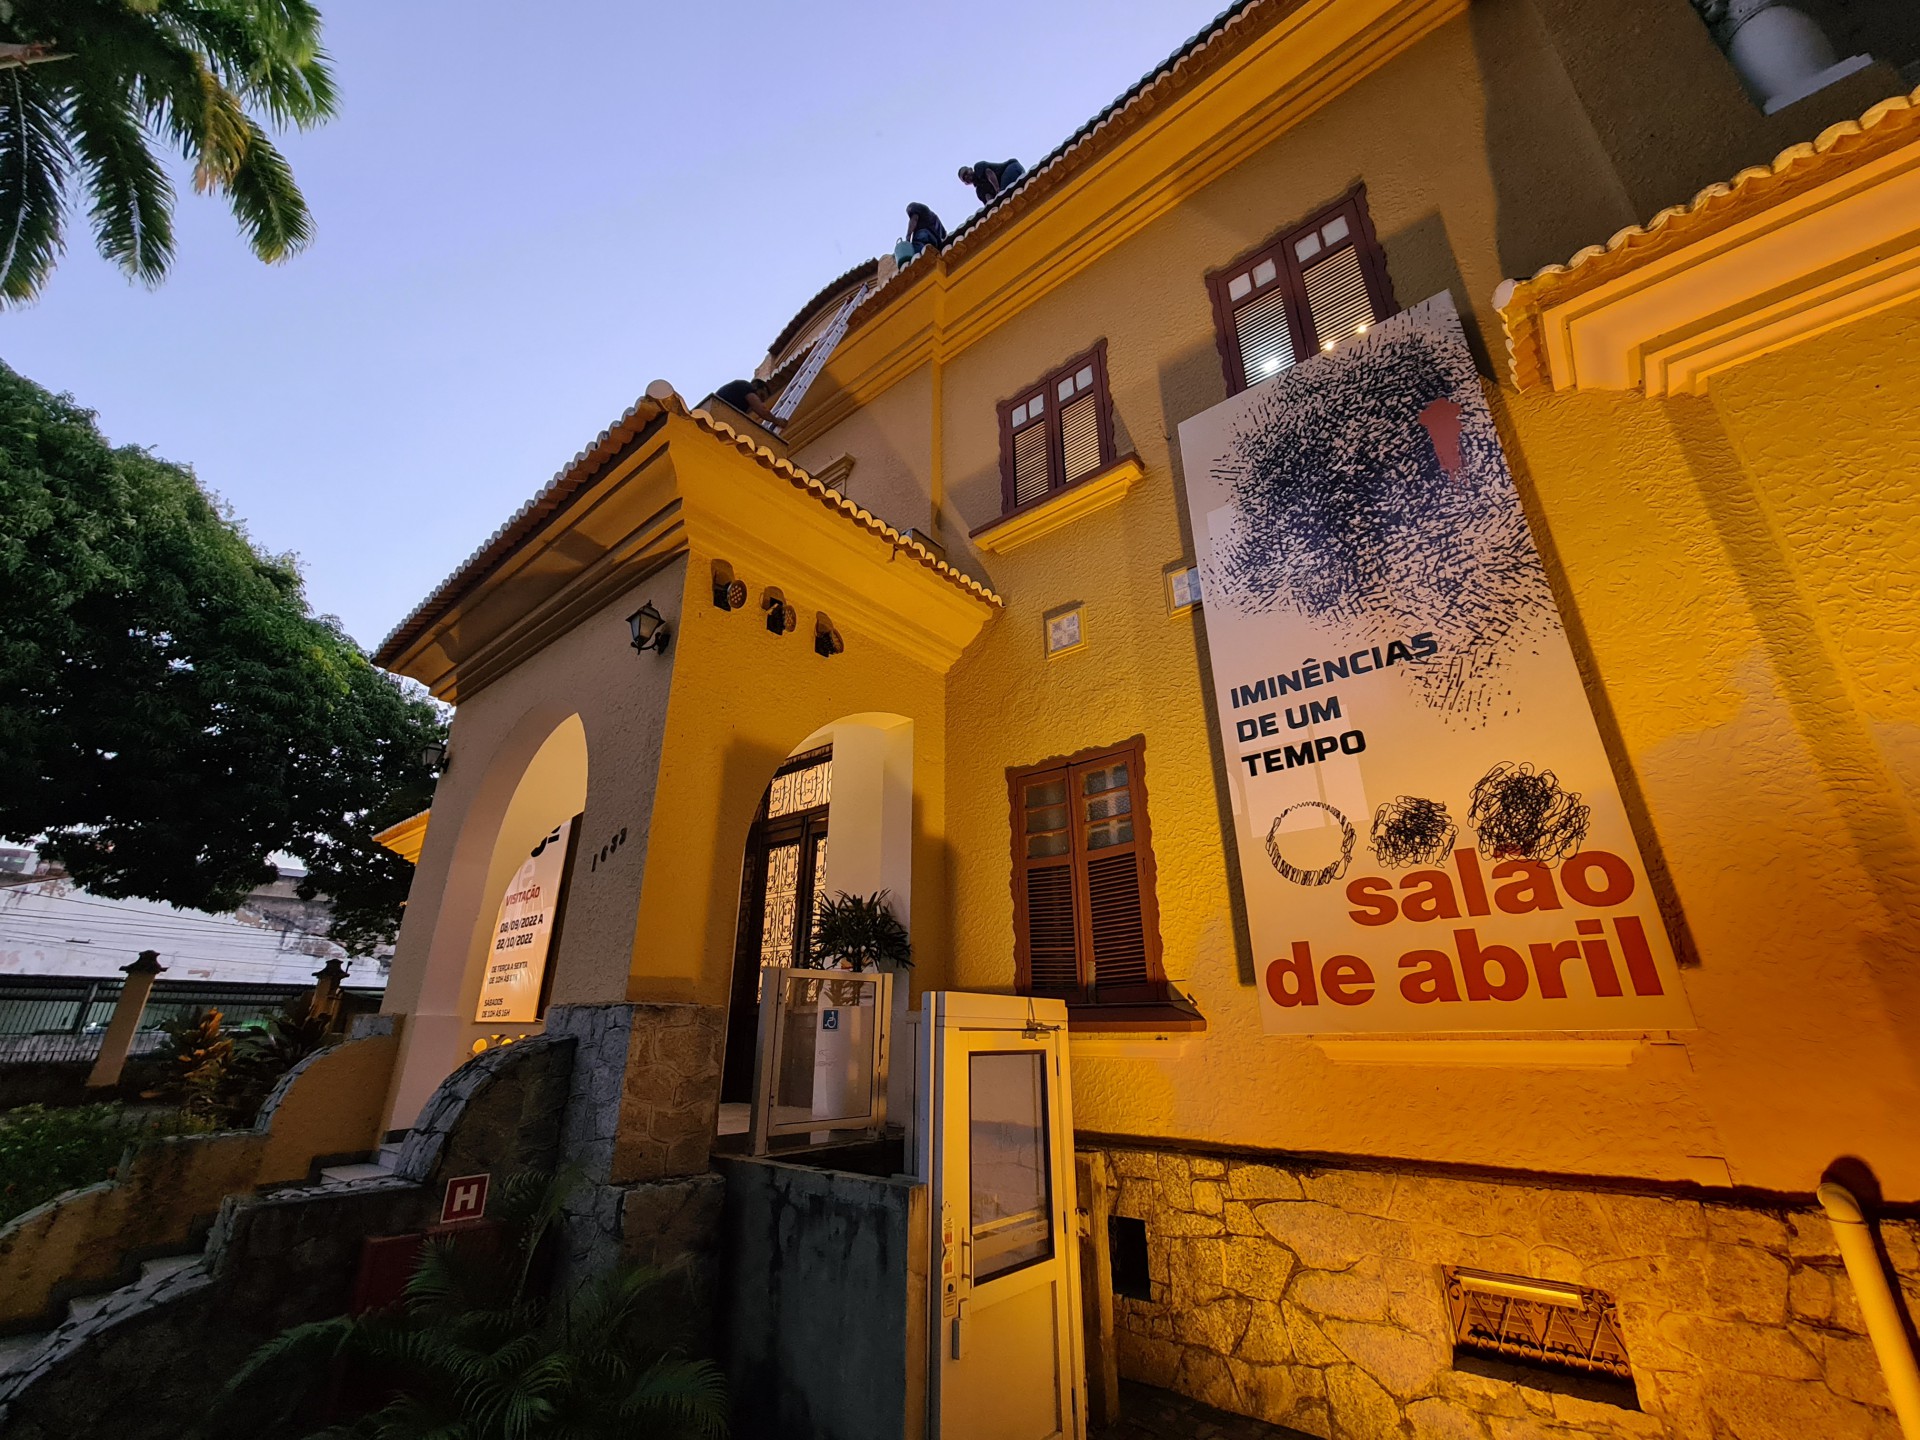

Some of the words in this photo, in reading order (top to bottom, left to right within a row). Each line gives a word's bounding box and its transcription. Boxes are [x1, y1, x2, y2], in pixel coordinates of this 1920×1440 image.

[1230, 631, 1439, 709] IMINÊNCIAS
[1236, 711, 1279, 743] DE
[1285, 695, 1342, 731] UM
[1241, 729, 1367, 777] TEMPO
[506, 884, 541, 906] VISITAÇÃO
[1345, 843, 1635, 926] salão
[496, 933, 534, 950] 22/10/2022
[500, 914, 538, 933] 08/09/2022
[538, 914, 543, 924] A
[1265, 941, 1376, 1008] de
[1397, 915, 1664, 1004] abril
[452, 1184, 479, 1212] H
